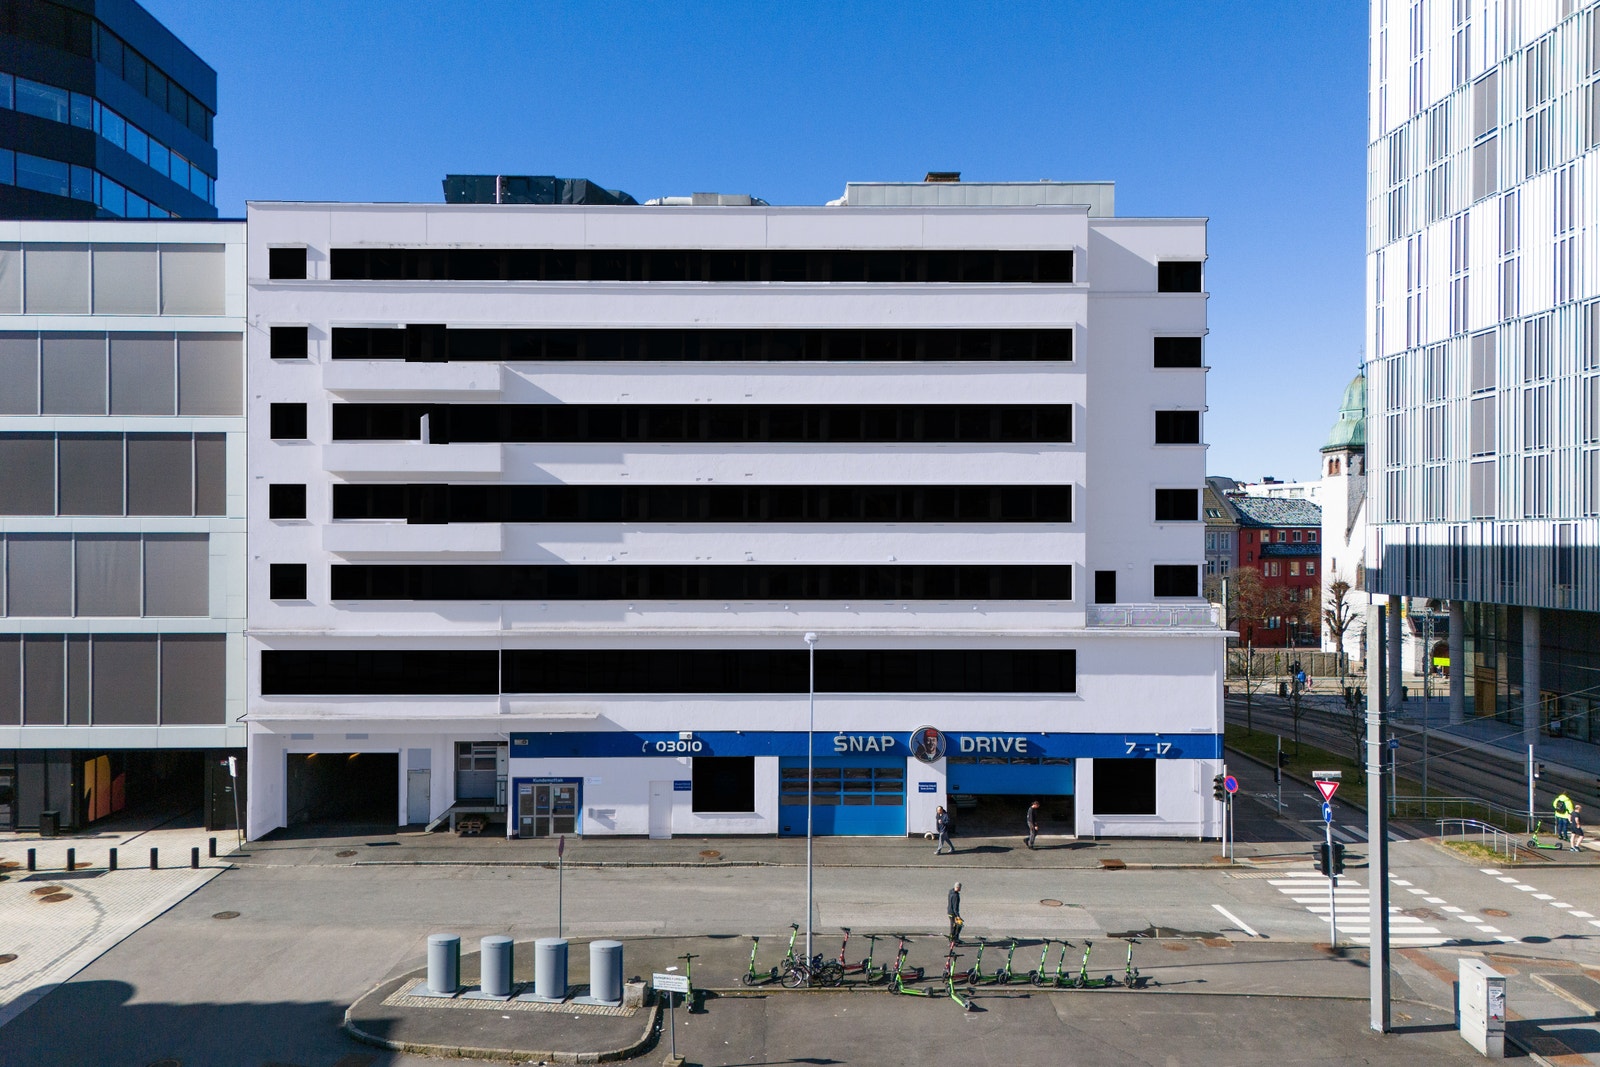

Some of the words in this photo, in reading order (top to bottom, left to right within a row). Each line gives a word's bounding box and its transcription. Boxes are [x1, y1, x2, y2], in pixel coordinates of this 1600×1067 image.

[656, 741, 702, 752] 03010
[833, 735, 895, 752] SNAP
[960, 736, 1027, 753] DRIVE
[1125, 742, 1136, 754] 7
[1157, 742, 1172, 754] 17
